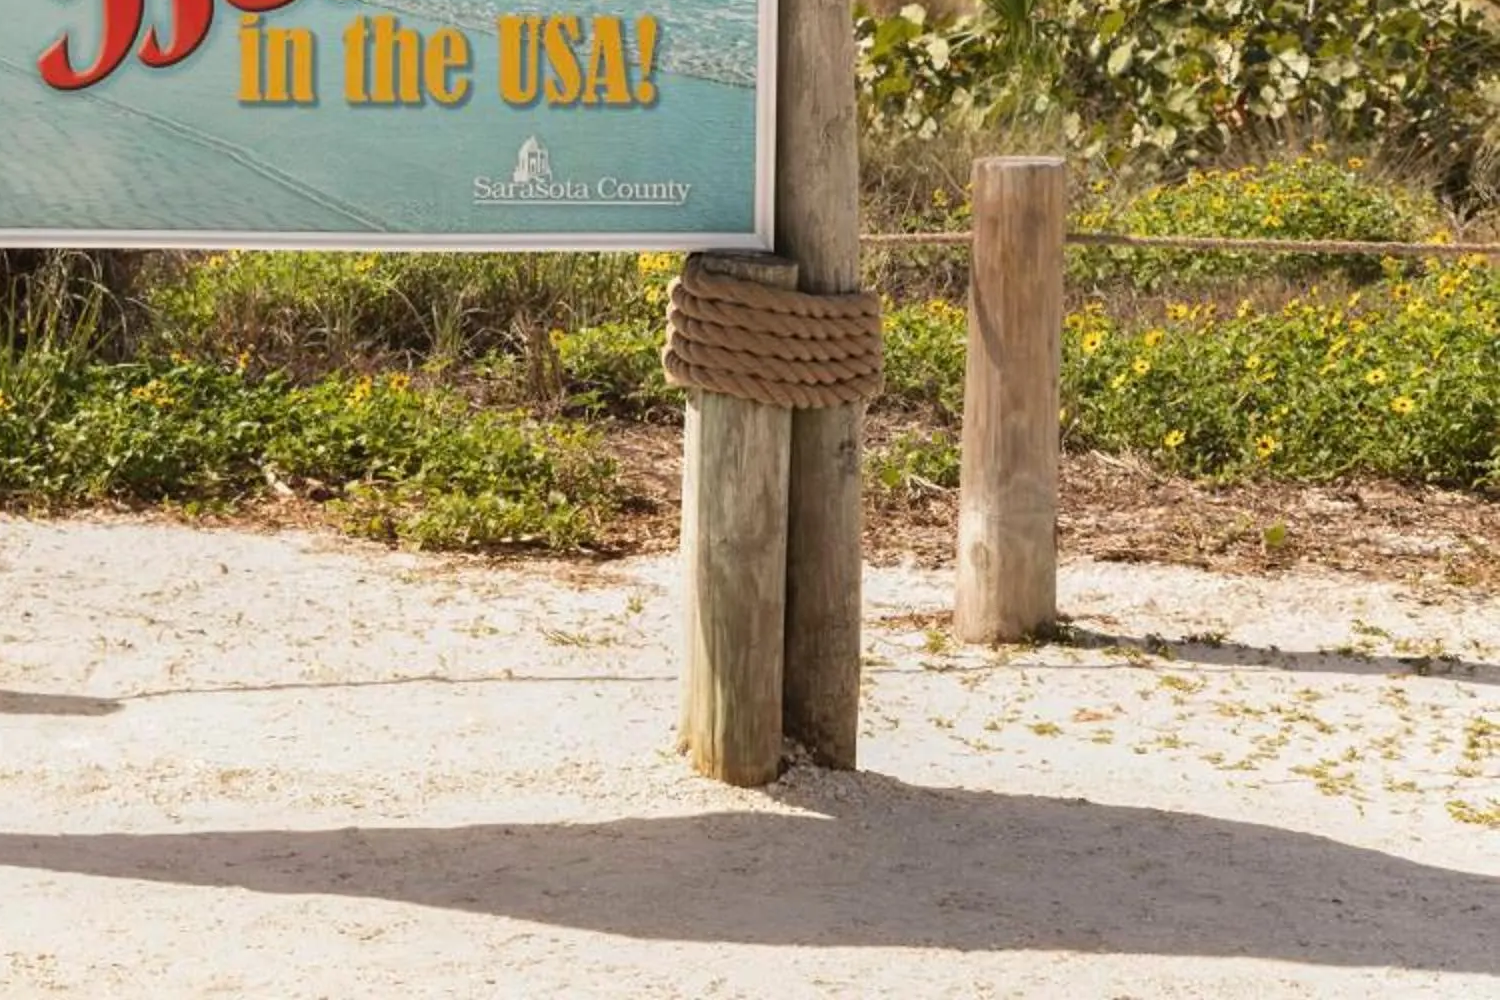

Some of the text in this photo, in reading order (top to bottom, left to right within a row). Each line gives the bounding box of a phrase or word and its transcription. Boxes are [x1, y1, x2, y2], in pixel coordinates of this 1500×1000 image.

[238, 13, 660, 106] in the USA!
[472, 176, 692, 201] Sarasota County
